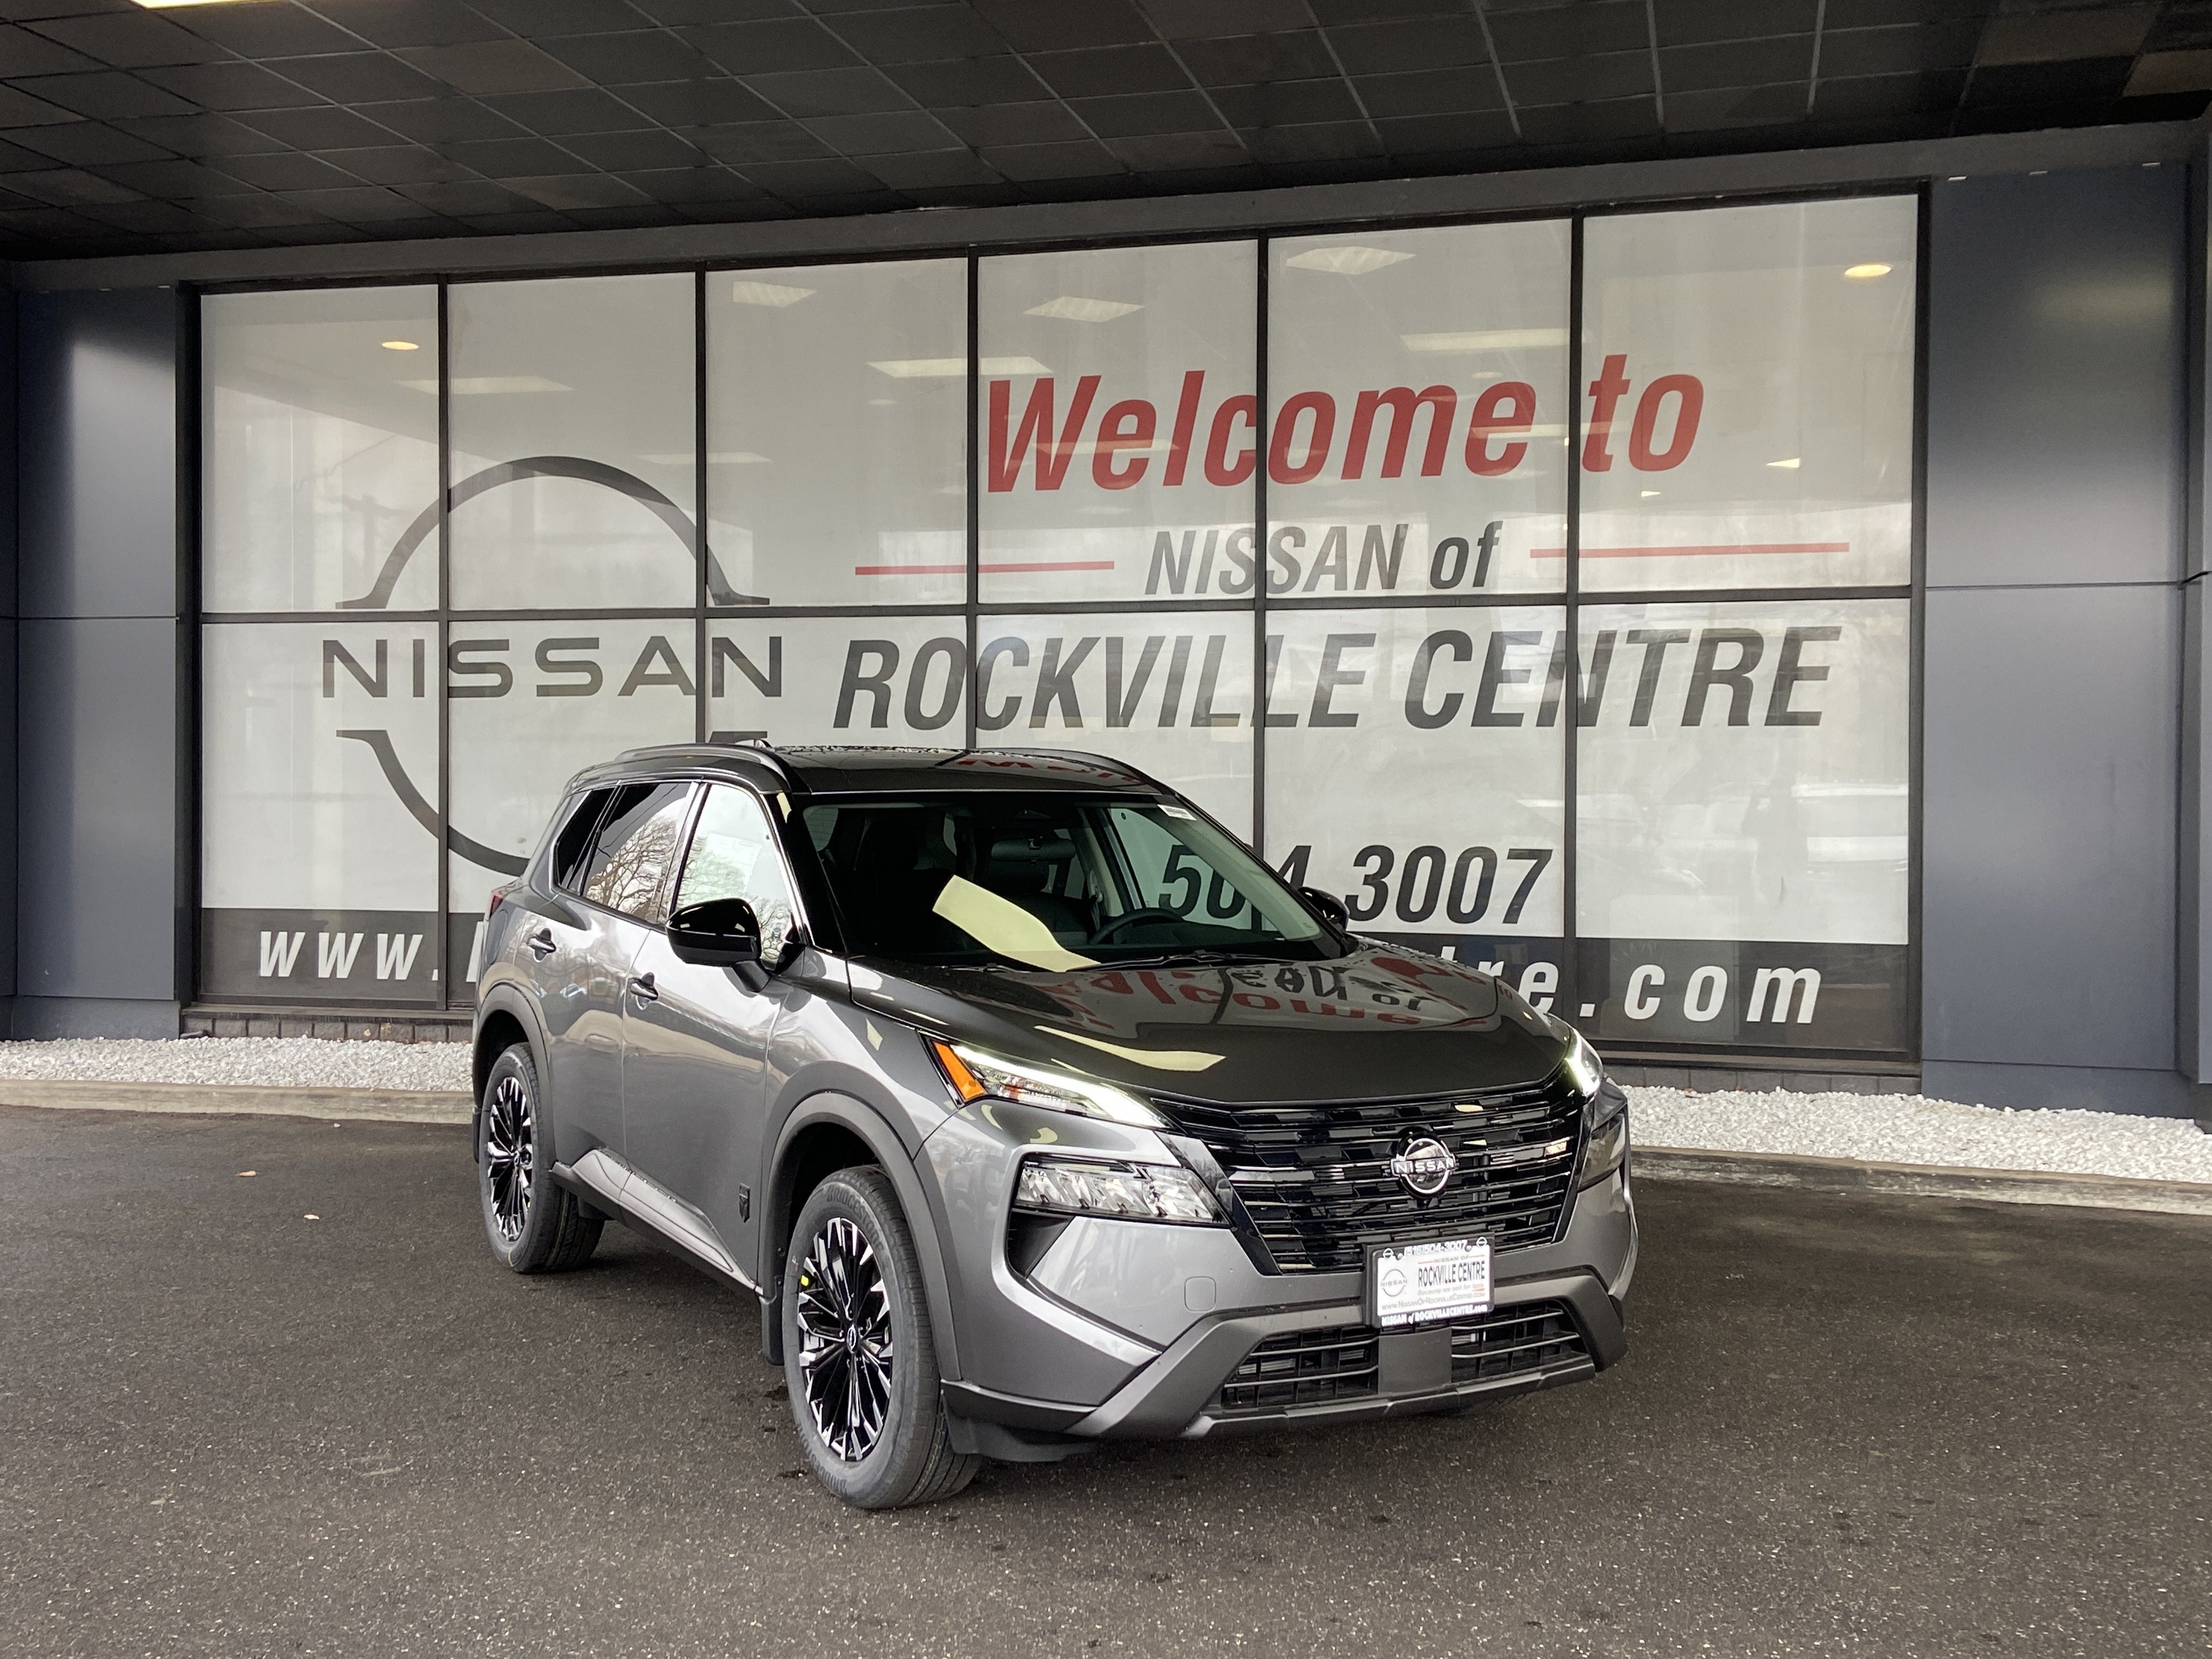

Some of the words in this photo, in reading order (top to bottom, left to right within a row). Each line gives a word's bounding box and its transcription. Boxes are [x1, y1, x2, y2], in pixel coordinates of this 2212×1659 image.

[988, 370, 1537, 493] Welcome
[1581, 353, 1705, 472] to
[1144, 523, 1409, 595] NISSAN
[1429, 520, 1503, 590] of
[323, 635, 782, 698] NISSAN
[832, 632, 1376, 731] ROCKVILLE
[1403, 625, 1842, 729] CENTRE
[1345, 844, 1554, 924] 3007
[1395, 1157, 1454, 1173] NISSAN
[1380, 1279, 1408, 1287] NISSAN
[1418, 1264, 1456, 1287] ROCKVILLE
[1458, 1261, 1485, 1282] CENTRE
